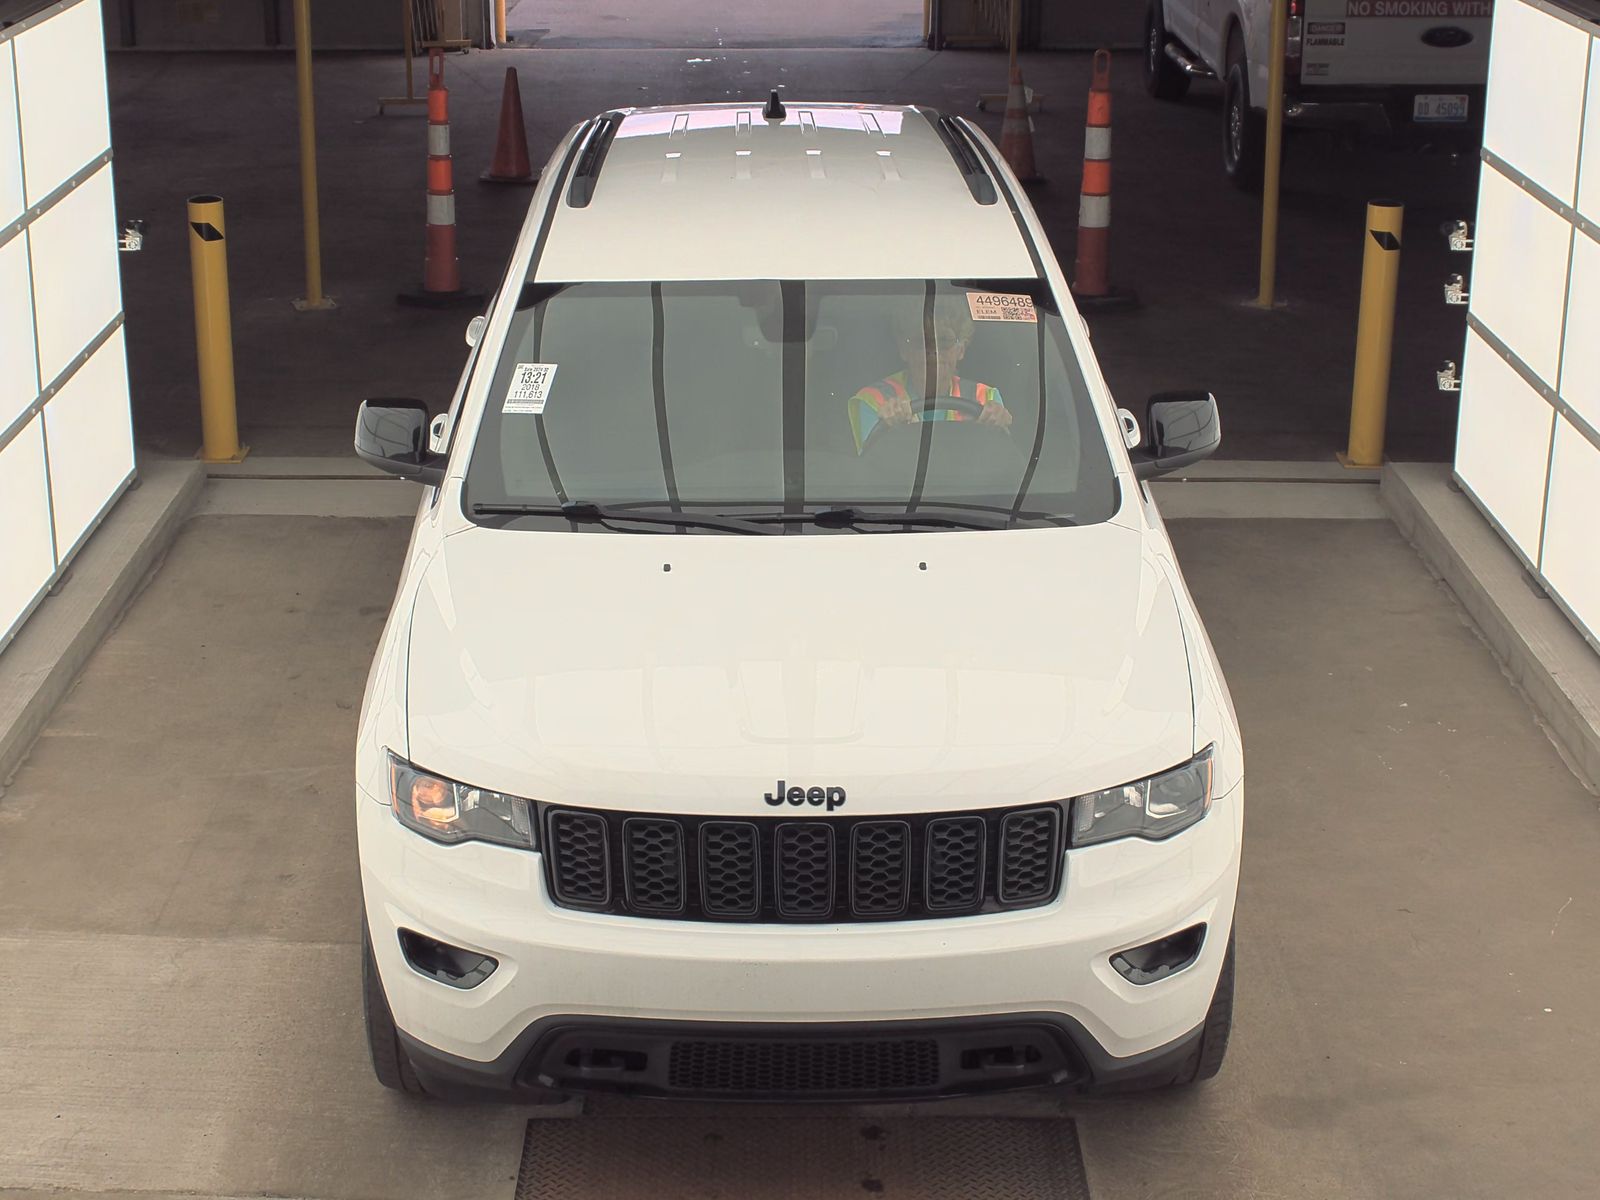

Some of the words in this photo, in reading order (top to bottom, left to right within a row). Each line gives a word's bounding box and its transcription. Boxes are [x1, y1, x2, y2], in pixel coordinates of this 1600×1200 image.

[1348, 2, 1370, 16] NO
[1375, 1, 1447, 16] SMOKING
[1306, 38, 1345, 46] FLAMMABLE
[976, 295, 1033, 307] 4496489
[521, 371, 547, 384] 13:21
[521, 383, 541, 391] 2018
[514, 390, 543, 399] 111,613
[764, 780, 846, 811] Jeep
